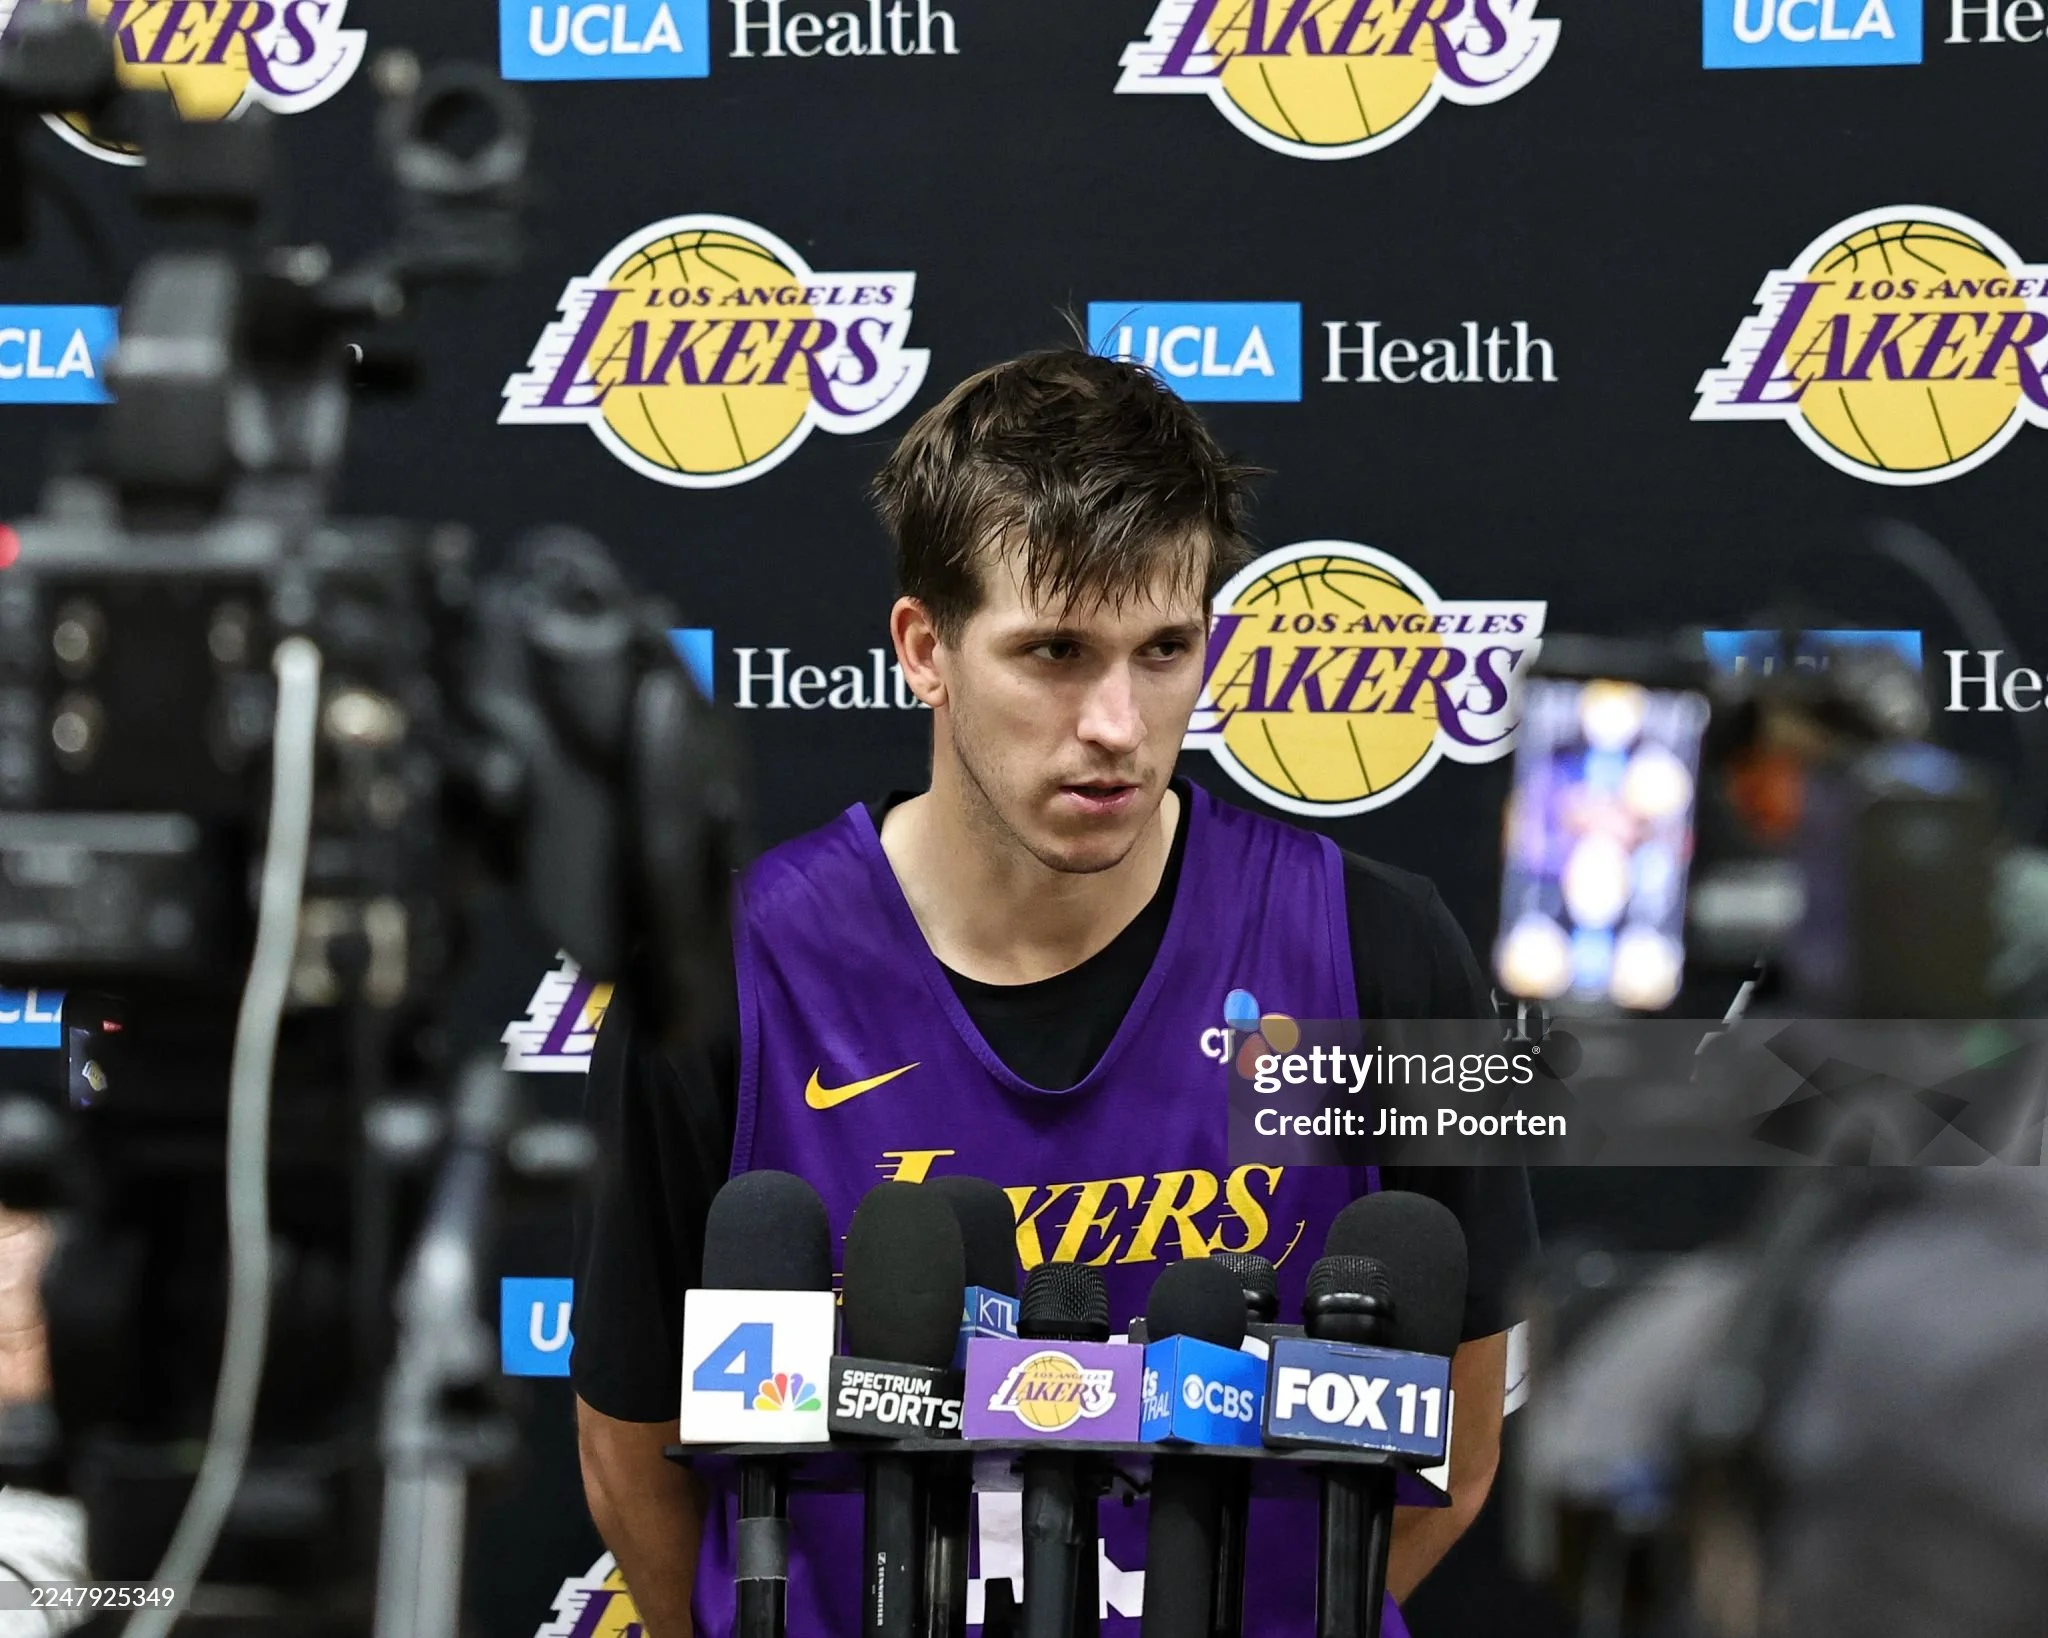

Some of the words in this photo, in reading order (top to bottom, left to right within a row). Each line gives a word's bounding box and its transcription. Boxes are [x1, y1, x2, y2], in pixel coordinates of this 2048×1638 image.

[529, 5, 683, 56] UCLA
[729, 0, 960, 57] Health
[1138, 0, 1540, 87] LAKERS
[1733, 0, 1896, 43] UCLA
[1944, 0, 2048, 43] He
[0, 0, 347, 96] KERS
[645, 286, 713, 307] LOS
[719, 285, 897, 307] ANGELES
[1845, 279, 1919, 300] LOS
[521, 289, 910, 417] LAKERS
[1118, 325, 1276, 378] UCLA
[1321, 321, 1559, 383] Health
[1715, 281, 2048, 411] LAKER
[1267, 614, 1340, 634] LOS
[1344, 613, 1528, 634] ANGELES
[733, 648, 934, 710] Healt
[1942, 649, 2048, 712] He
[1200, 1027, 1236, 1065] CJ
[873, 1149, 1306, 1275] KERS
[980, 1294, 1018, 1334] KTL
[692, 1322, 774, 1411] 4
[841, 1369, 932, 1395] SPECTRUM
[836, 1387, 963, 1430] SPORTS
[1001, 1372, 1109, 1413] LAKERS
[1142, 1391, 1170, 1423] TRAL
[1205, 1381, 1254, 1423] CBS
[1275, 1366, 1391, 1431] FOX
[1396, 1383, 1441, 1438] 11
